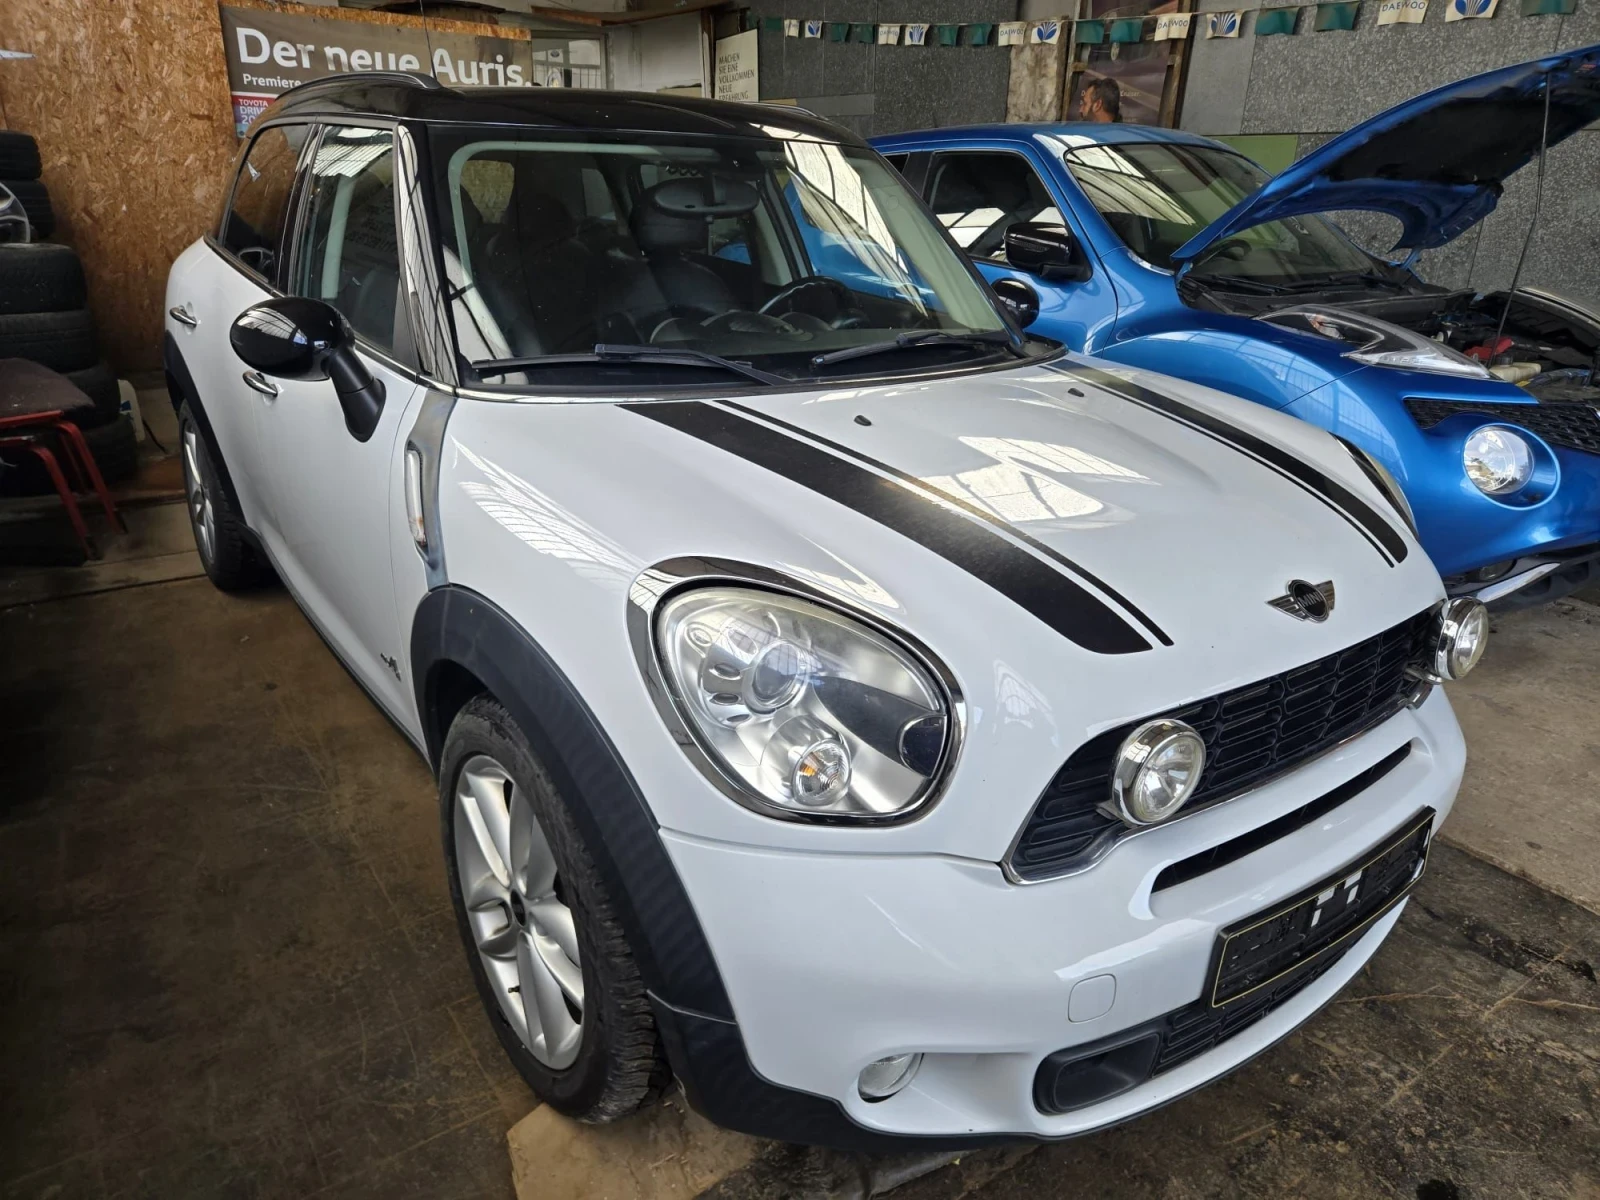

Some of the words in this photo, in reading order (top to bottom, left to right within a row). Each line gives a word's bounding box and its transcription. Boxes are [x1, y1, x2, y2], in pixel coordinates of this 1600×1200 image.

[1381, 1, 1426, 12] DAEWOO
[236, 27, 315, 69] Der
[323, 45, 420, 73] neue
[430, 48, 532, 87] Auris.
[719, 53, 740, 65] MACHEN
[243, 73, 302, 89] Premiere
[719, 68, 755, 84] VOLLKOMMEN
[719, 83, 732, 94] NEUE
[238, 98, 269, 108] TOYOTA
[240, 106, 267, 116] DRIV
[1297, 591, 1323, 607] MINI
